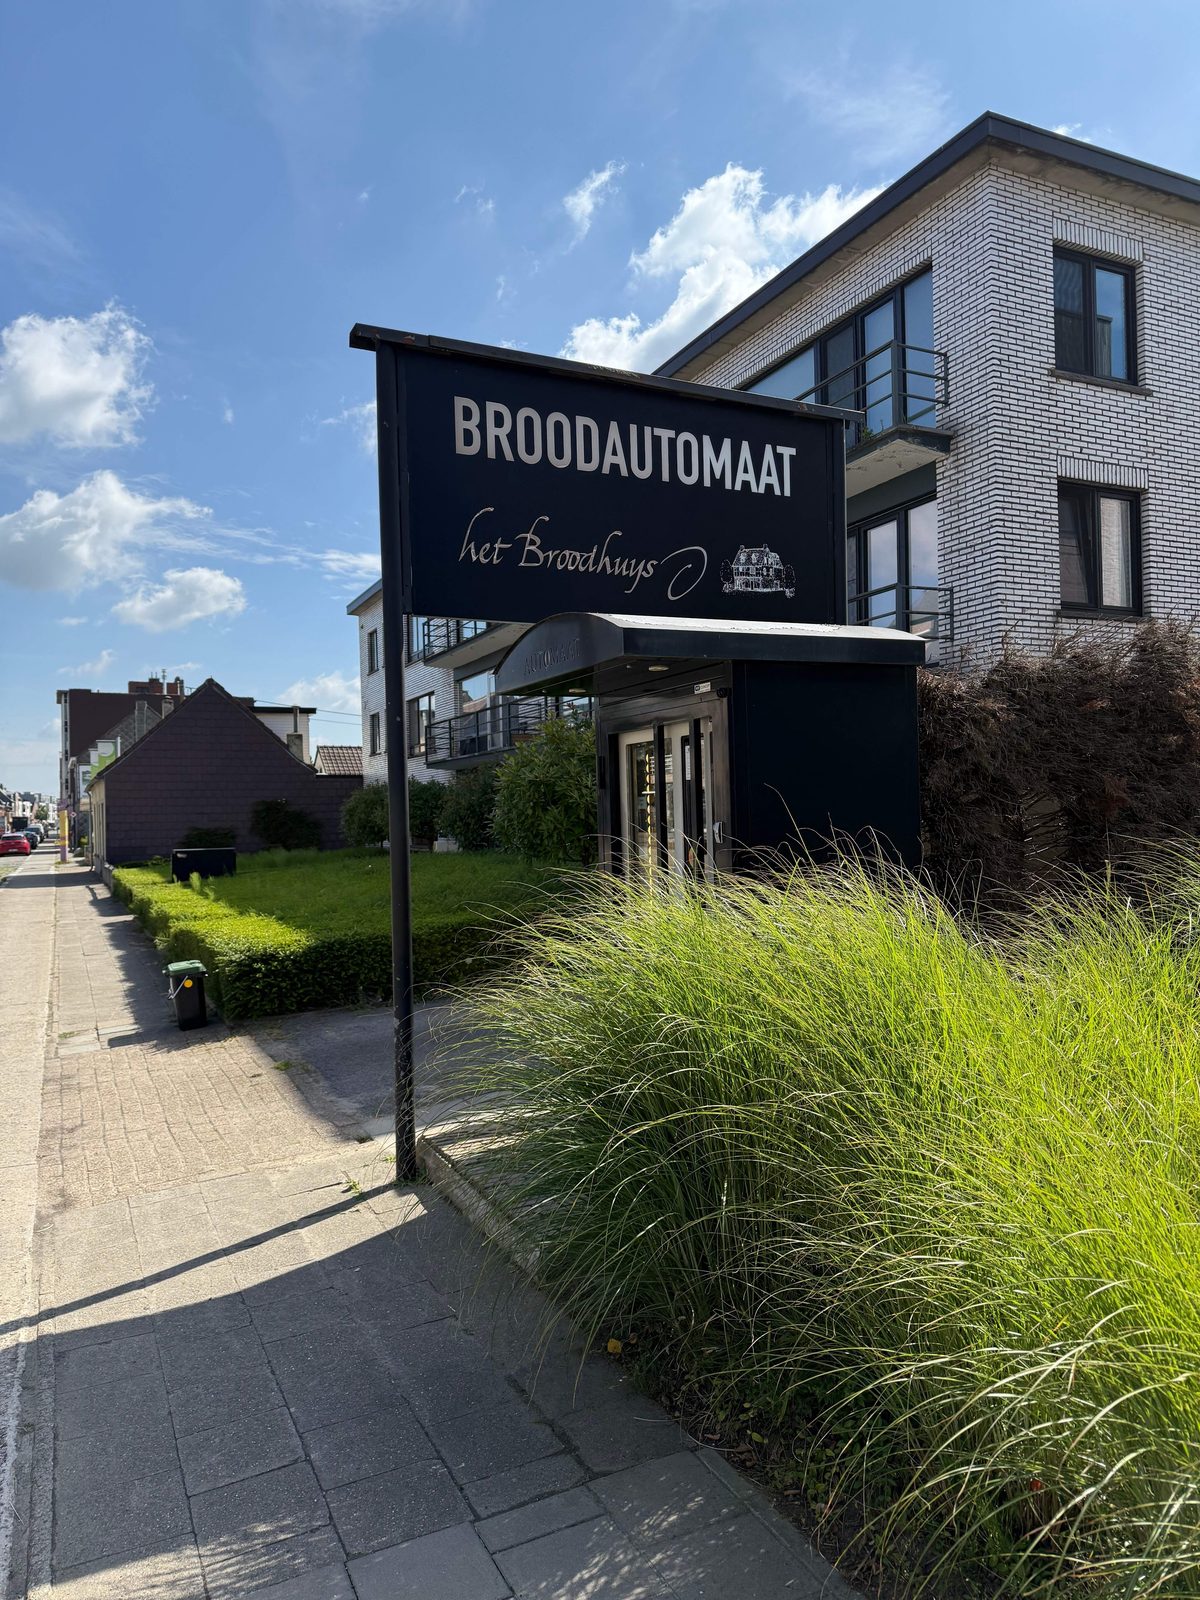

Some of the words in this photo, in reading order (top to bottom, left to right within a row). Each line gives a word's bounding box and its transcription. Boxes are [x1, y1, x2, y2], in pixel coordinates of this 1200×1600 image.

[454, 396, 797, 497] BROODAUTOMAAT
[458, 507, 512, 565] het
[515, 515, 659, 594] Broodhuys
